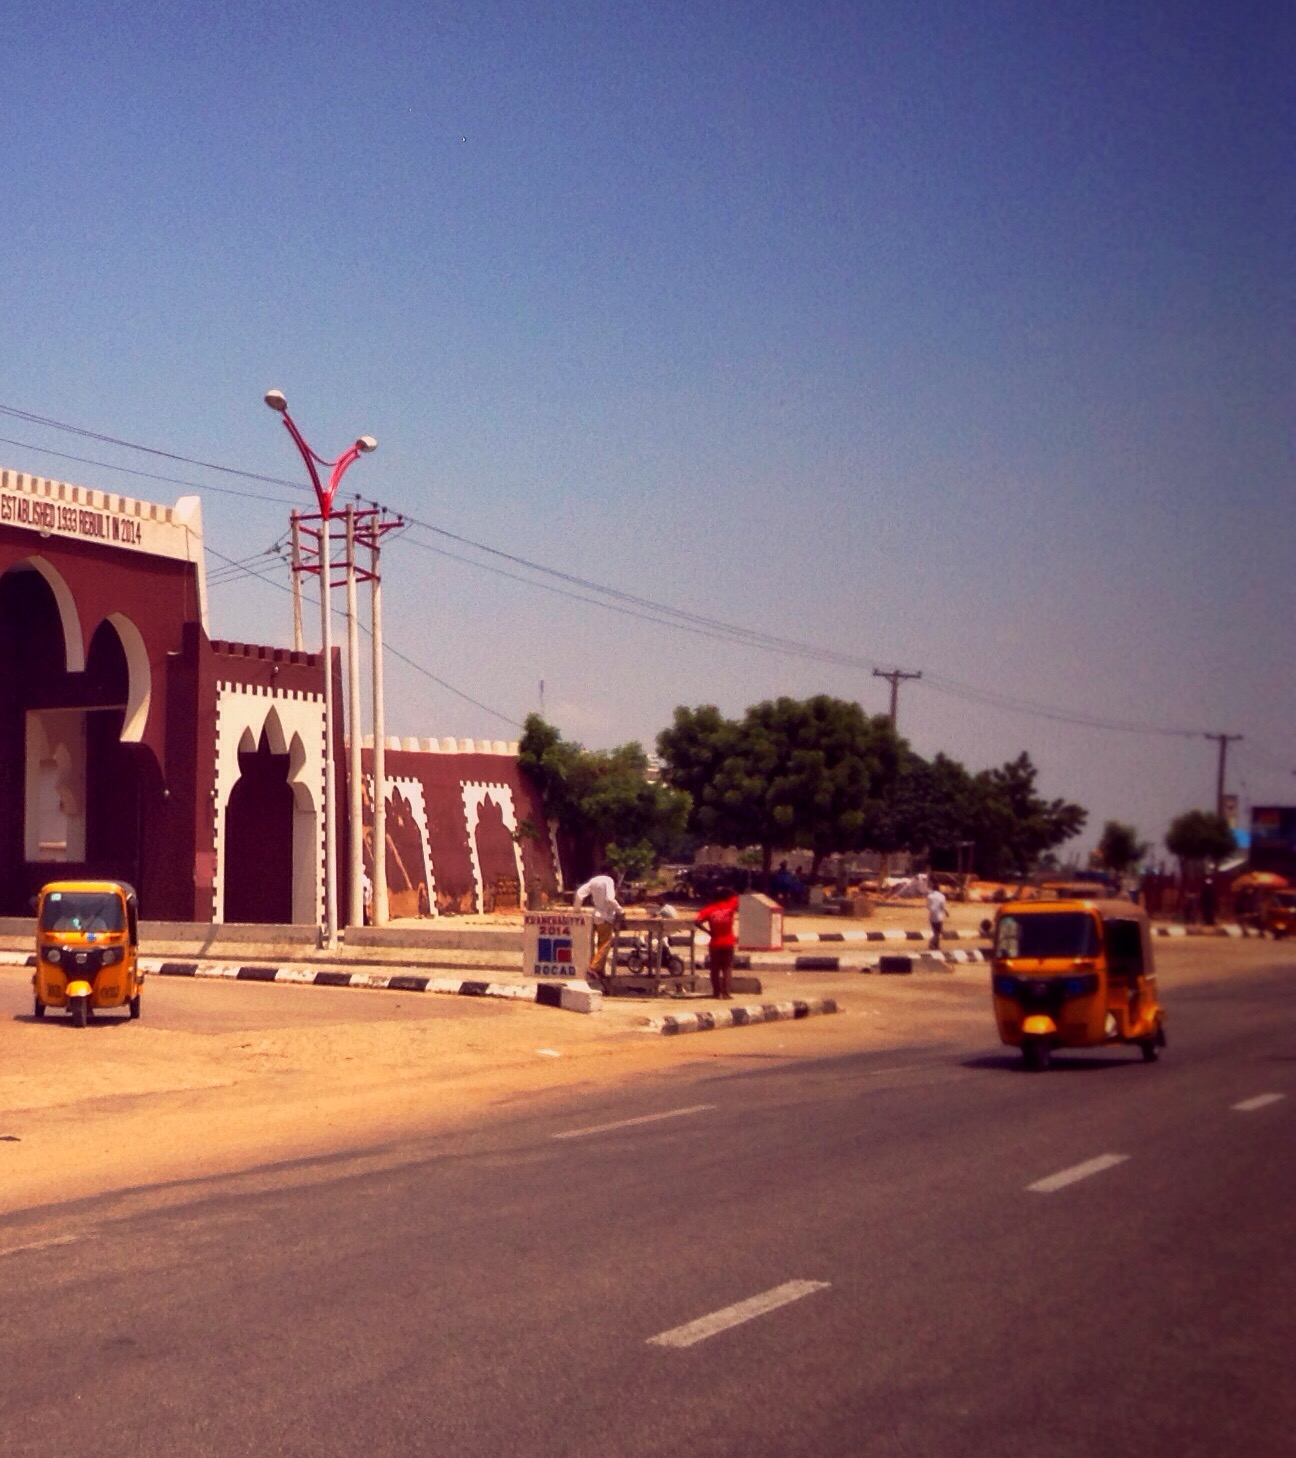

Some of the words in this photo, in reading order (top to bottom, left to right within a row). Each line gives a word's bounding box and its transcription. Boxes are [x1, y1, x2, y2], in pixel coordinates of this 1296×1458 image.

[1, 494, 55, 528] ESTABLISHED
[57, 506, 77, 532] 1933
[79, 509, 110, 539] REBUILT
[112, 516, 120, 540] IN
[121, 518, 141, 545] 2014
[539, 926, 570, 935] 2014
[534, 965, 576, 975] ROCAD
